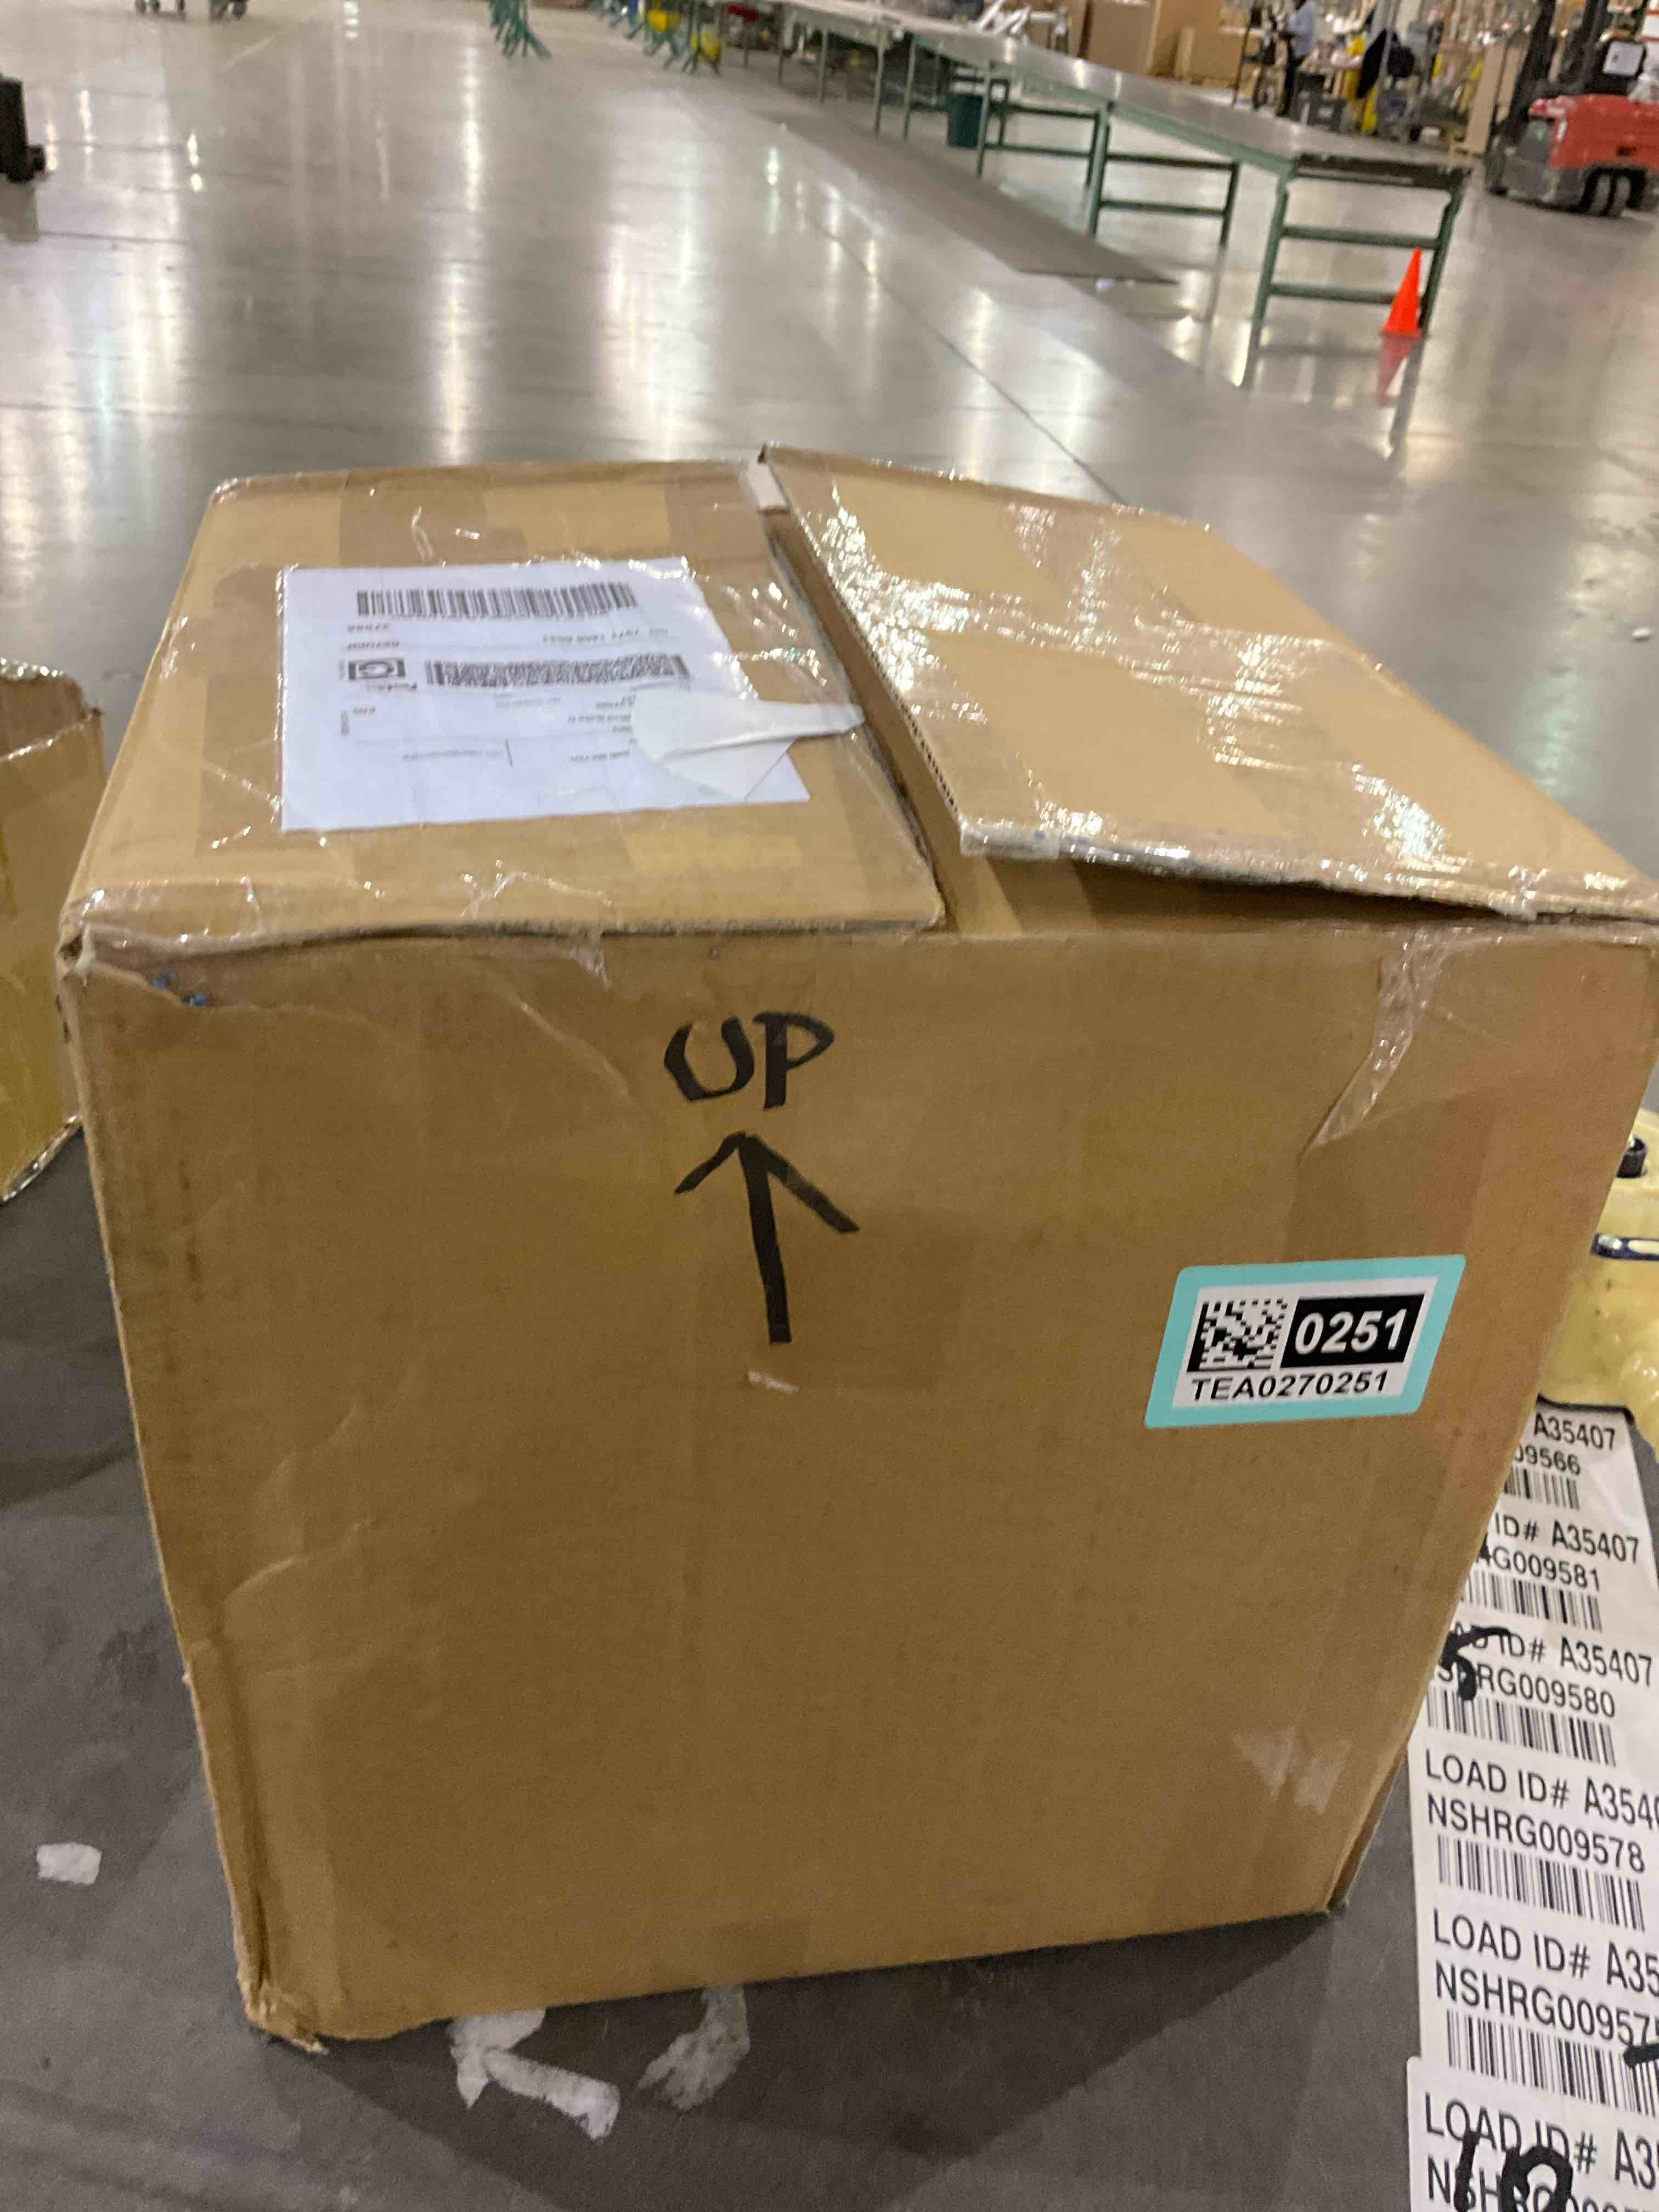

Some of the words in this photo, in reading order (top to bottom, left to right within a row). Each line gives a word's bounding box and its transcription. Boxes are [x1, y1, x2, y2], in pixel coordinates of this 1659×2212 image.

[663, 1011, 835, 1110] UP
[1294, 1308, 1407, 1355] 0251
[1192, 1369, 1389, 1401] TEA0270251
[1534, 1413, 1615, 1451] A35407
[1480, 1543, 1600, 1590] G009581
[1495, 1513, 1539, 1542] ID#
[1553, 1521, 1639, 1564] A35407
[1500, 1630, 1545, 1662] ID#
[1560, 1637, 1652, 1687] A35407
[1425, 1748, 1507, 1793] LOAD
[1518, 1770, 1571, 1810] ID#
[1427, 1792, 1645, 1874] NSHRG009578
[1432, 1908, 1521, 1962] LOAD
[1534, 1934, 1591, 1980] ID#
[1435, 1960, 1659, 2047] NSHRG00957
[1425, 2092, 1521, 2152] LOAD
[1535, 2119, 1597, 2174] ID#
[1615, 2128, 1659, 2191] A3
